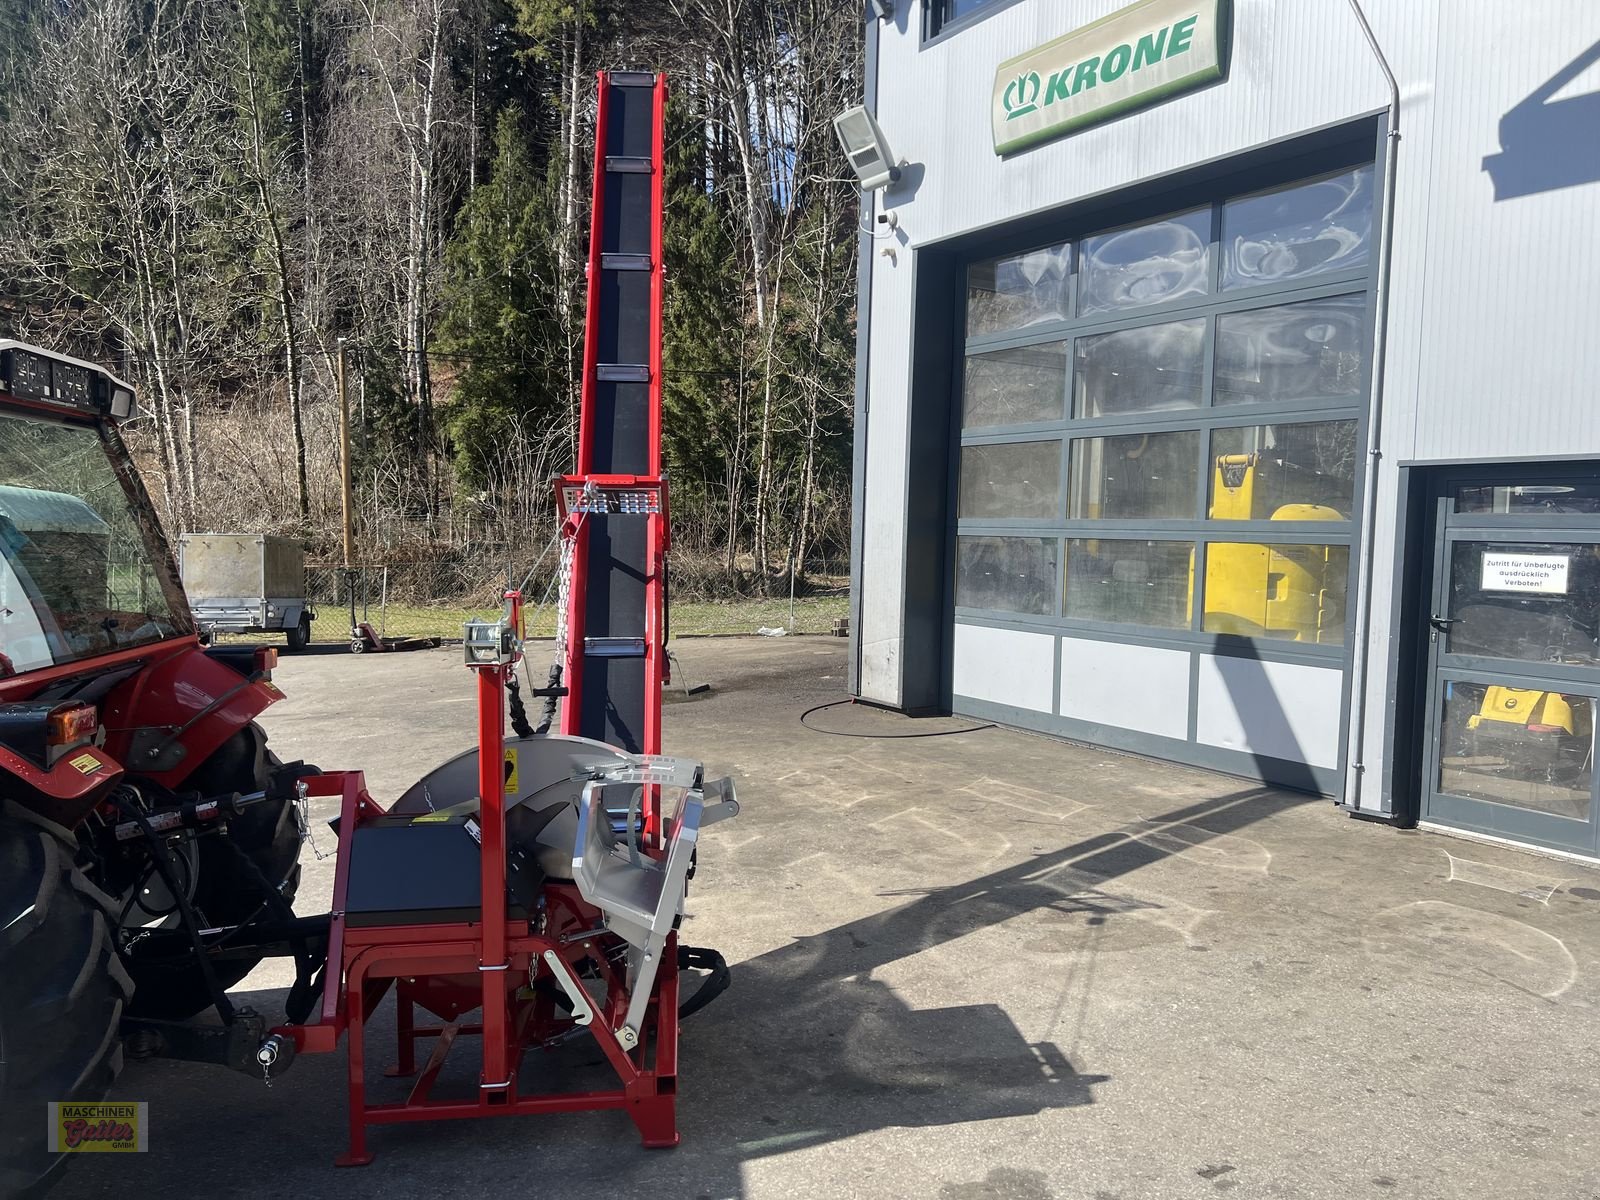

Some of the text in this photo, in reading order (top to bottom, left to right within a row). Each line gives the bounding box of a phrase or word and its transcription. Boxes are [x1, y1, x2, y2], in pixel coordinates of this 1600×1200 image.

[1043, 14, 1199, 107] KRONE
[1511, 560, 1522, 568] für
[1524, 561, 1565, 571] Unbefugte
[1499, 570, 1550, 578] ausdrücklich
[1505, 579, 1543, 587] Verboten!
